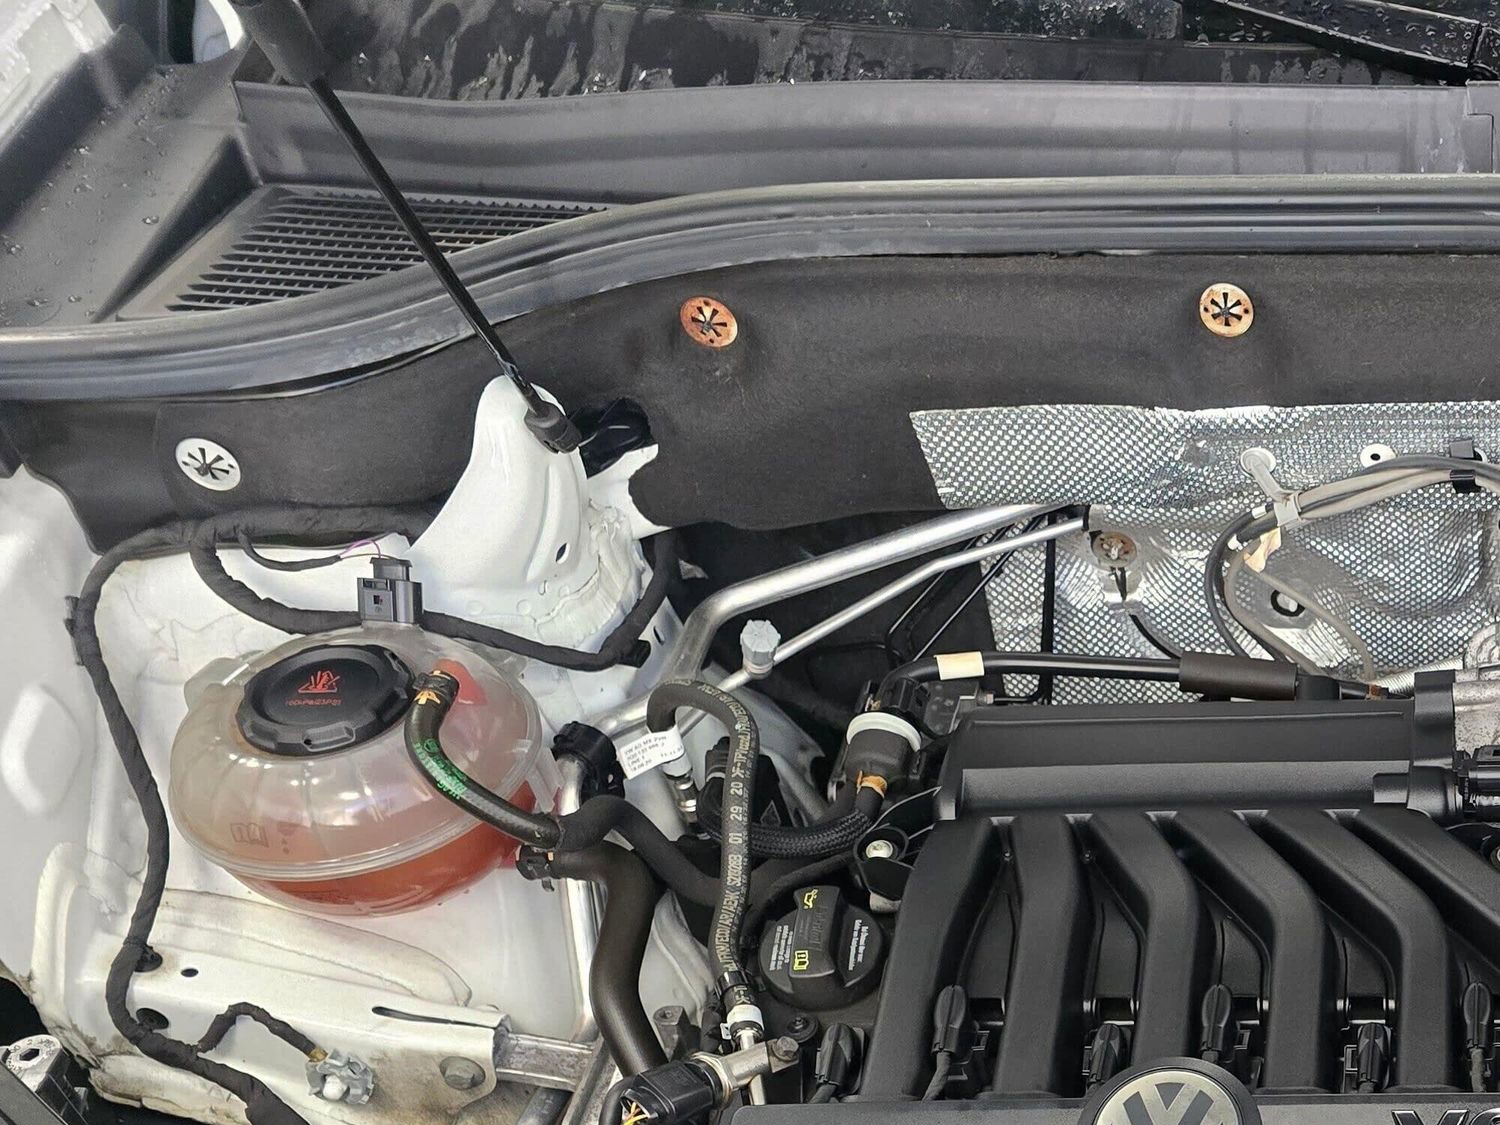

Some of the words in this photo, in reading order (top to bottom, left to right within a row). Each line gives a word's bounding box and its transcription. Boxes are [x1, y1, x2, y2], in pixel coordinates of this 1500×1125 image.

[730, 781, 743, 796] 20
[730, 806, 742, 822] 29
[729, 832, 742, 845] 01
